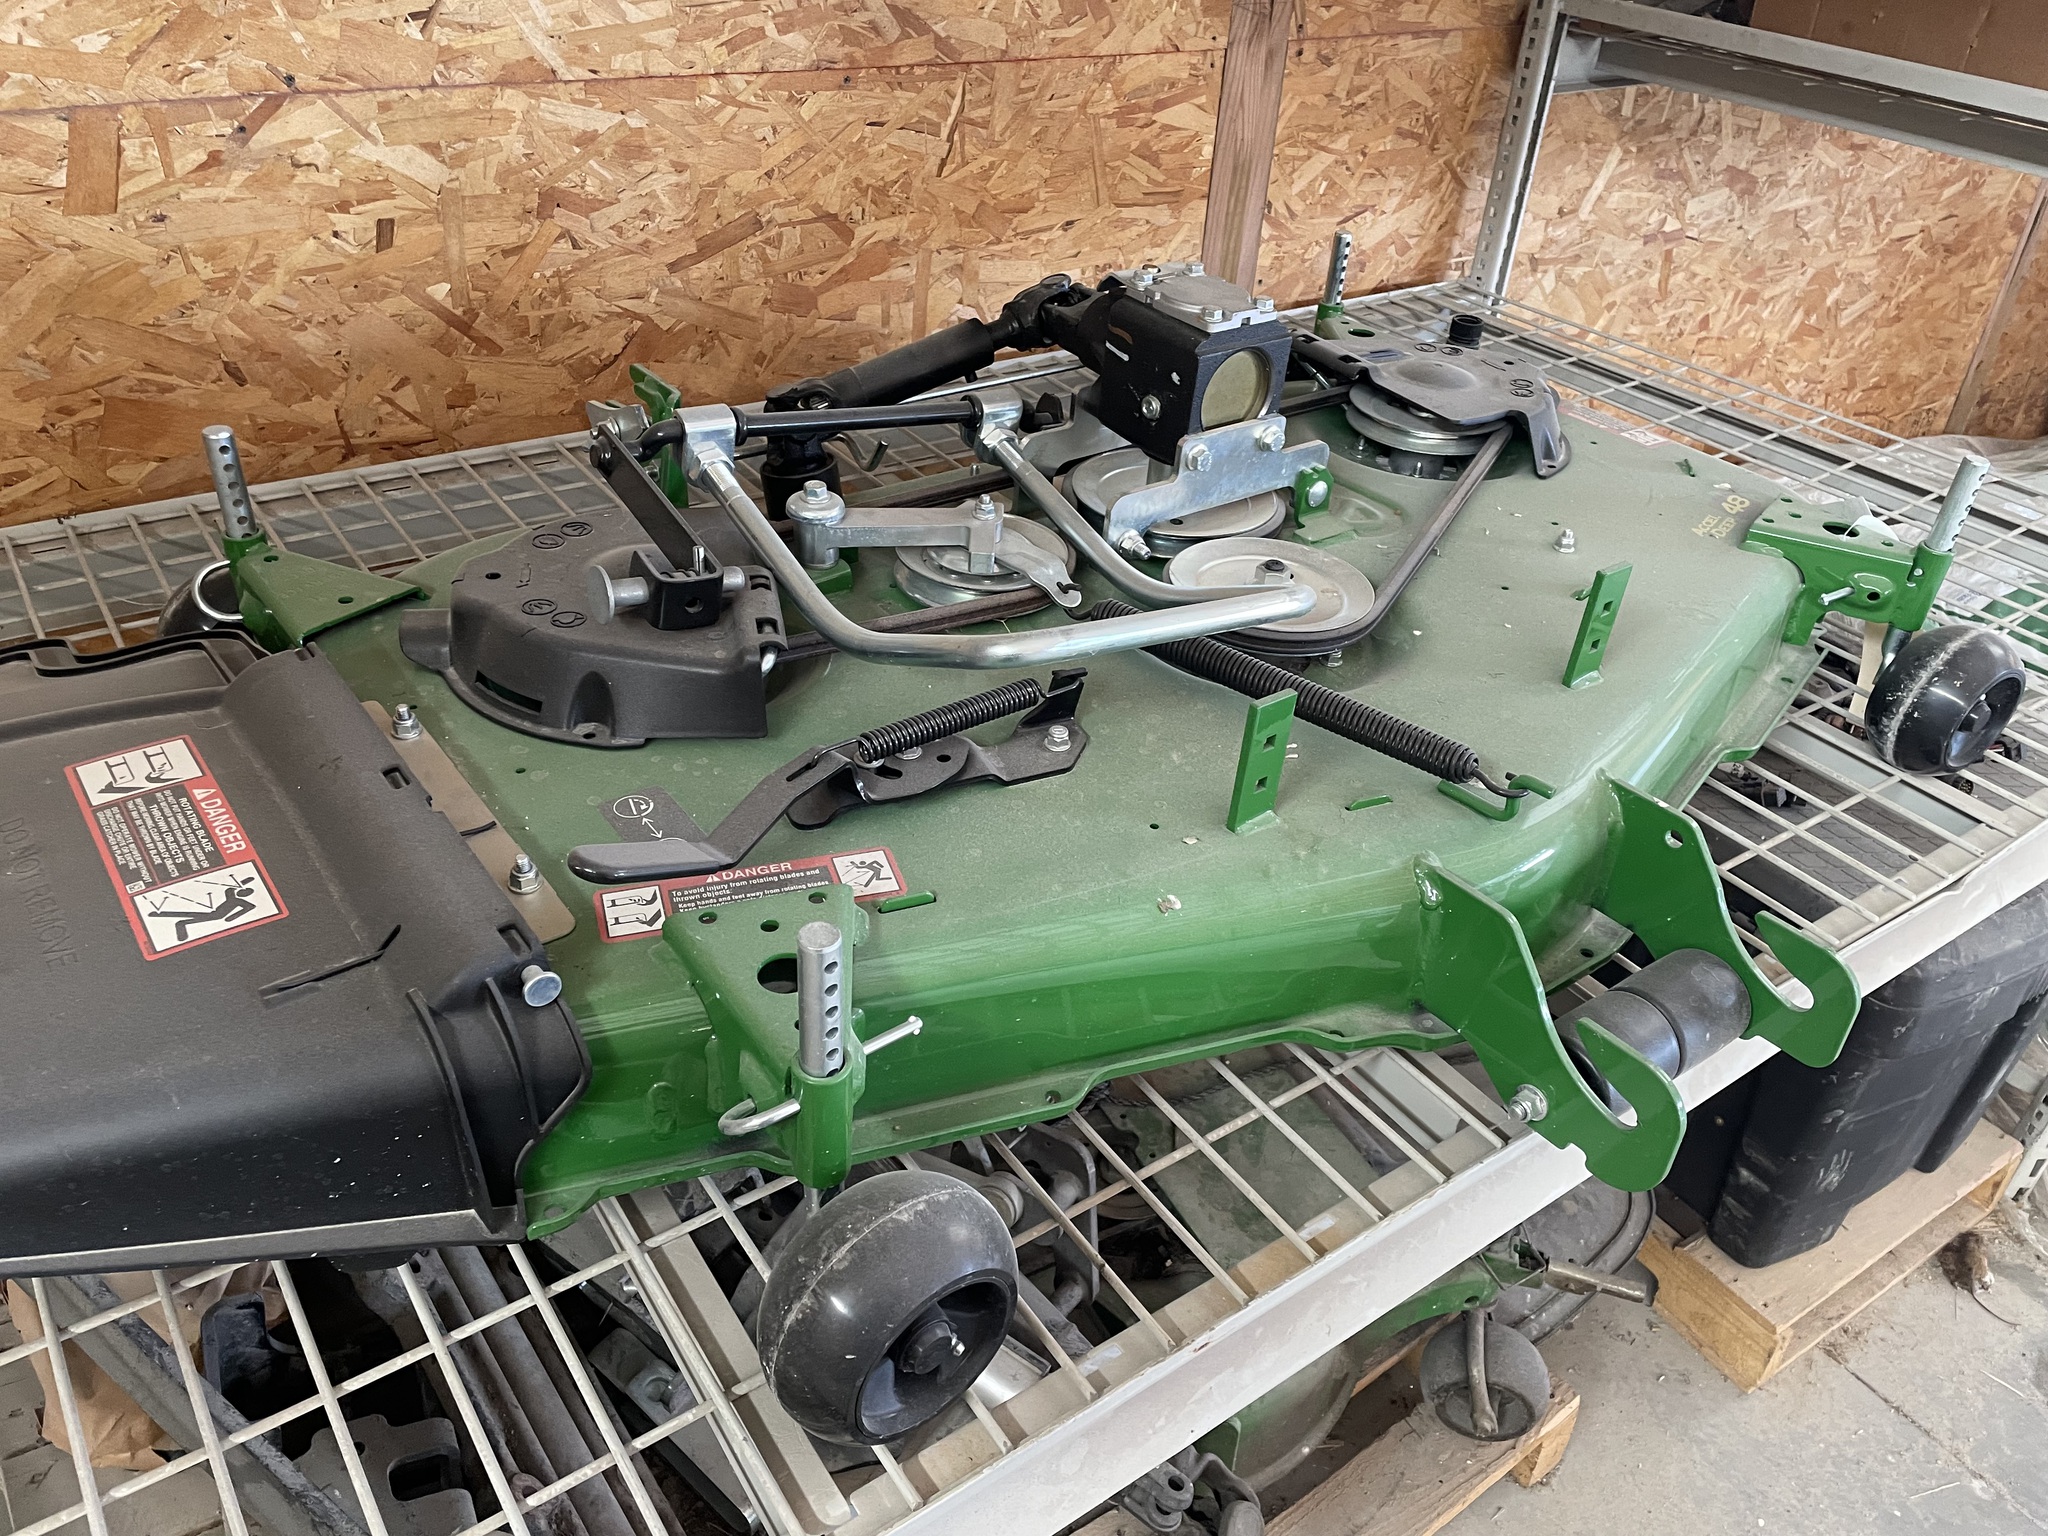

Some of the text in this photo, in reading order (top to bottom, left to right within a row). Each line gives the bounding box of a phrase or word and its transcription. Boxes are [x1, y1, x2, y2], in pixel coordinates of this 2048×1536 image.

[1721, 495, 1750, 515] 48
[166, 795, 177, 804] NOT
[170, 803, 181, 813] PUT
[113, 812, 124, 823] NOT
[134, 818, 143, 826] BE
[174, 811, 189, 827] HANDS
[177, 796, 214, 853] ROTATING BLADE
[199, 797, 247, 854] DANGER
[117, 822, 133, 843] OPERATE
[137, 825, 152, 844] THROWN
[148, 803, 185, 864] THROWN OBJECTS
[148, 827, 161, 842] CLEAR
[181, 826, 192, 834] OR
[102, 825, 117, 845] CATCHER
[113, 849, 126, 865] PLACE
[145, 842, 155, 850] BY
[154, 840, 167, 853] AREA
[166, 816, 180, 830] WHEN
[173, 828, 187, 845] ENGINE
[183, 849, 200, 871] RUNNING
[185, 833, 198, 845] FEET
[120, 845, 129, 853] OR
[127, 843, 142, 861] MOWER
[148, 849, 162, 865] BLADE
[190, 844, 206, 861] UNDER
[135, 860, 152, 883] WITHOUT
[162, 857, 179, 878] OBJECTS
[198, 859, 210, 868] OR
[722, 862, 792, 881] DANGER
[684, 886, 705, 895] avoid
[706, 882, 728, 892] injury
[729, 879, 747, 888] from
[749, 875, 779, 885] rotating
[780, 871, 805, 880] blades
[806, 868, 820, 876] and
[0, 817, 79, 969] DO NOT REMOVE
[673, 893, 700, 903] thrown
[697, 898, 717, 906] hands
[718, 895, 731, 903] and
[746, 891, 763, 899] away
[781, 884, 806, 893] rotating
